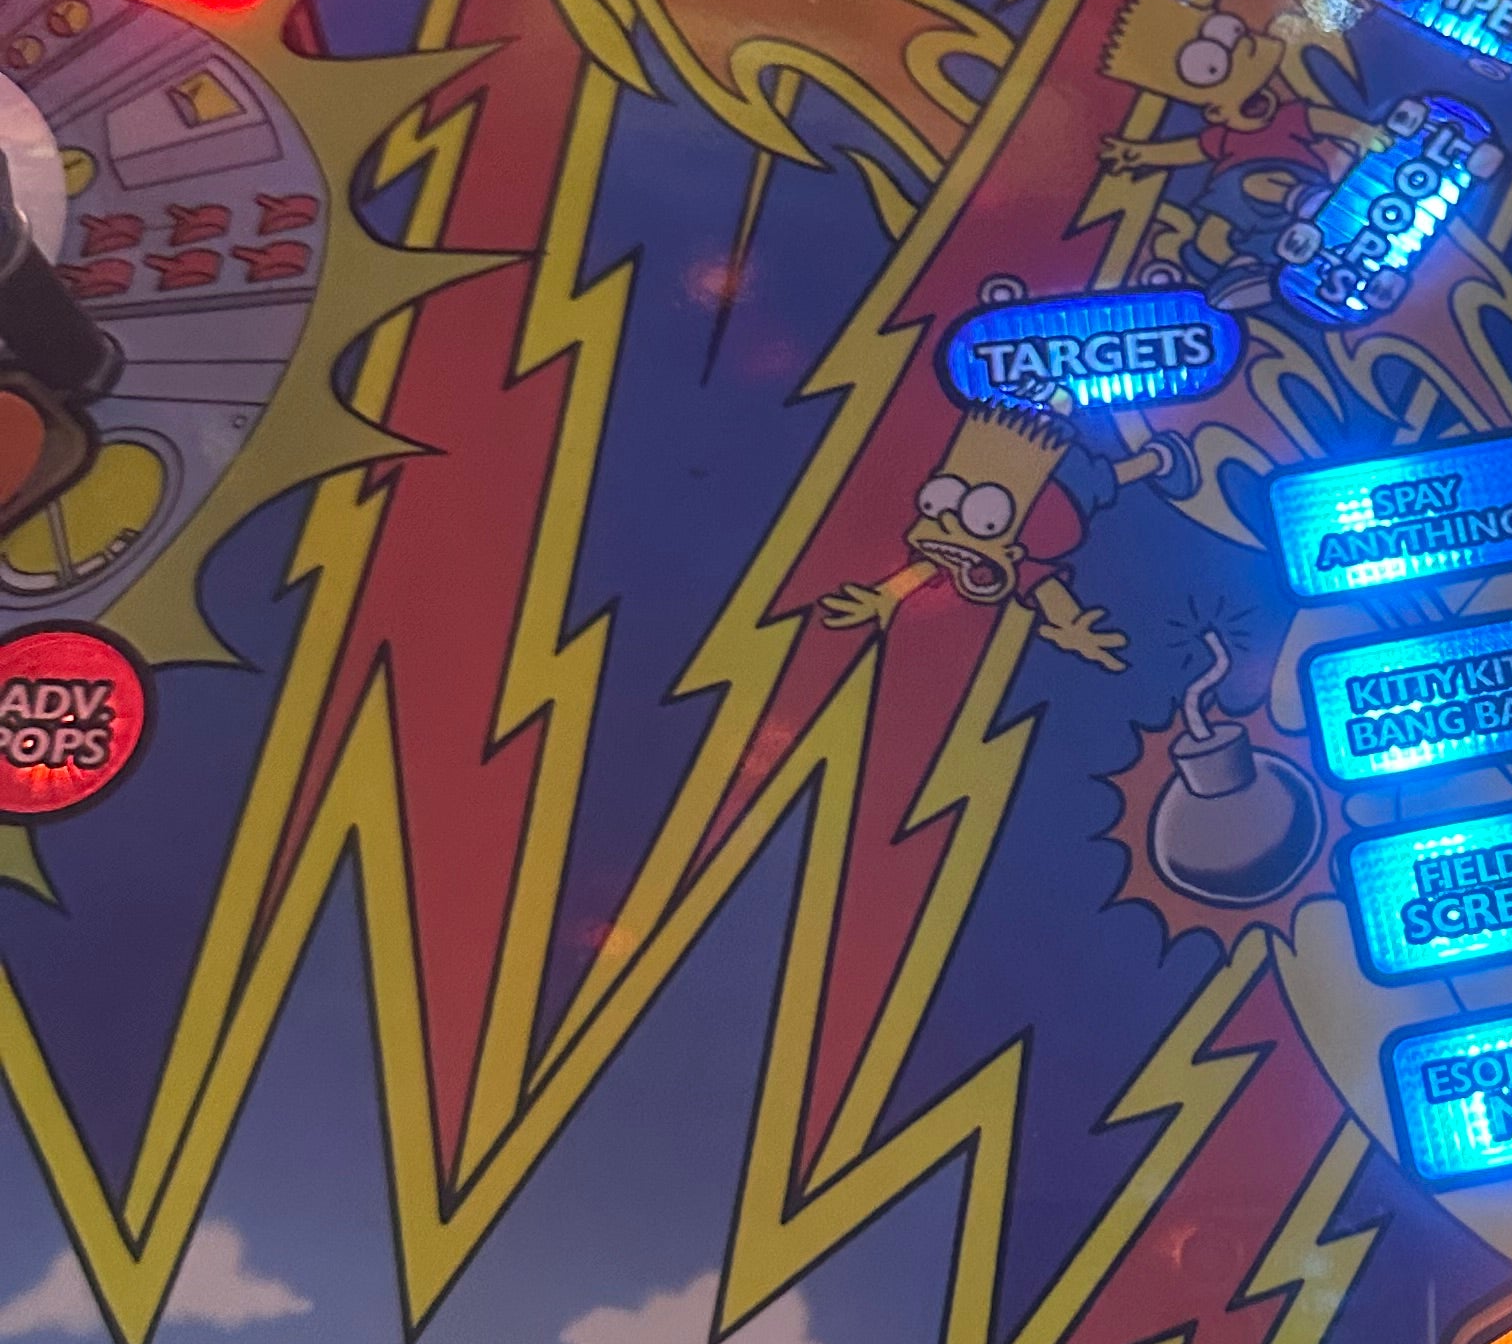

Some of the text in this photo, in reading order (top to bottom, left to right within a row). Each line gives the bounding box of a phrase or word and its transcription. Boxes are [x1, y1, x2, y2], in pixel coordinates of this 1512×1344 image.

[1318, 126, 1463, 303] LOOPS
[979, 327, 1211, 385] TARGETS
[1374, 477, 1458, 517] SPAY
[0, 683, 110, 721] ADV.
[1351, 664, 1456, 710] KITTY
[1352, 705, 1466, 753] BANG
